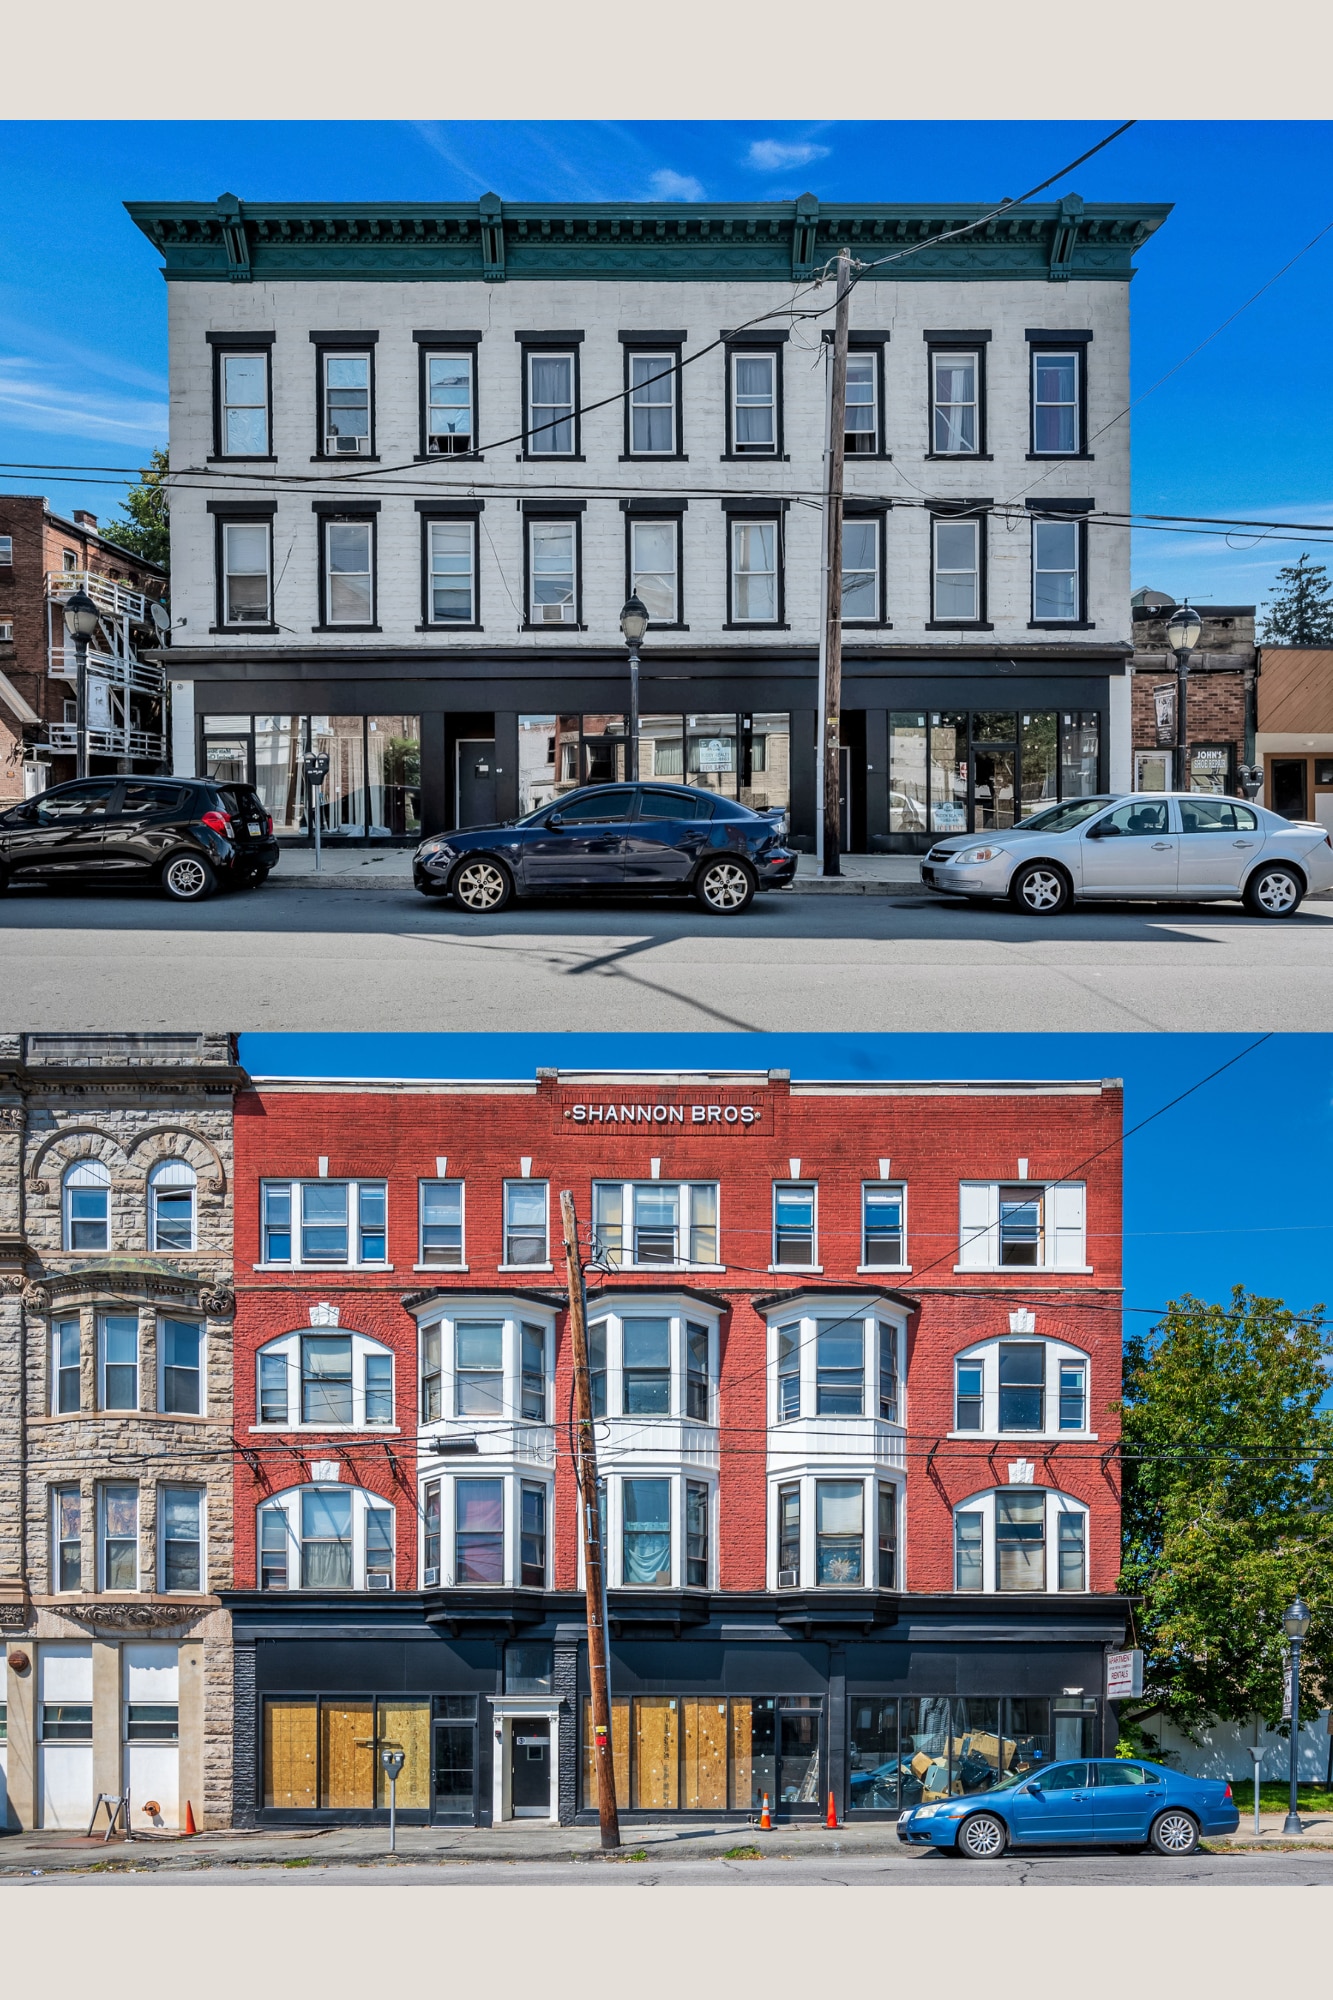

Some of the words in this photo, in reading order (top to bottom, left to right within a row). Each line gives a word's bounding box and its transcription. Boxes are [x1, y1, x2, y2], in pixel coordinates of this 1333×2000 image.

[1197, 751, 1222, 759] JOHN'S
[1194, 759, 1208, 769] SHOE
[1209, 759, 1226, 769] REPAIR
[572, 1105, 684, 1122] SHANNON
[691, 1106, 755, 1123] BROS
[1108, 1653, 1132, 1664] APARTMENT
[1111, 1670, 1128, 1680] RENTALS
